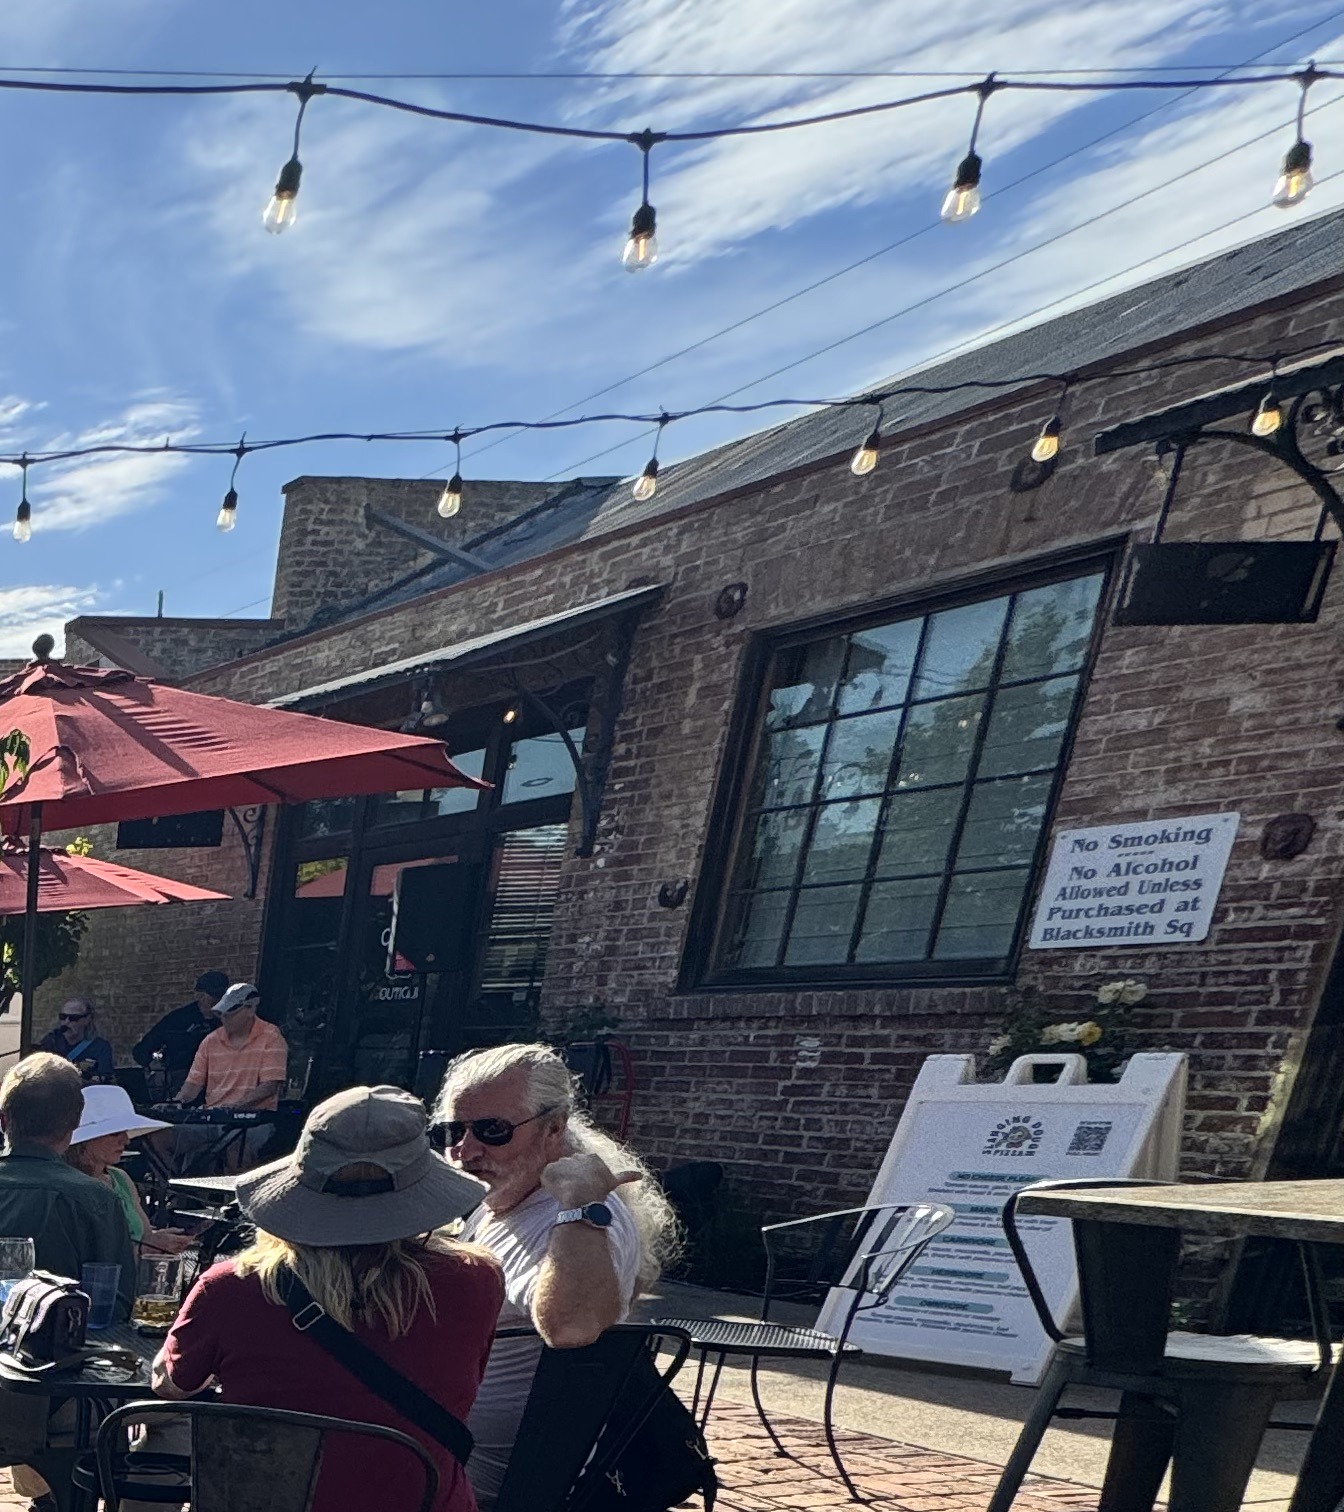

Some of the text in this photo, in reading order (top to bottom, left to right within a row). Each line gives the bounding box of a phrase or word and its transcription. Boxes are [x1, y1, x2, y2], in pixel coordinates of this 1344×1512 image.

[1070, 826, 1213, 853] No Smoking
[1068, 855, 1199, 881] No Alcohol
[1054, 876, 1203, 902] Allowed Unless
[1046, 897, 1201, 921] Purchased at
[1041, 920, 1194, 942] Blacksmith Sq
